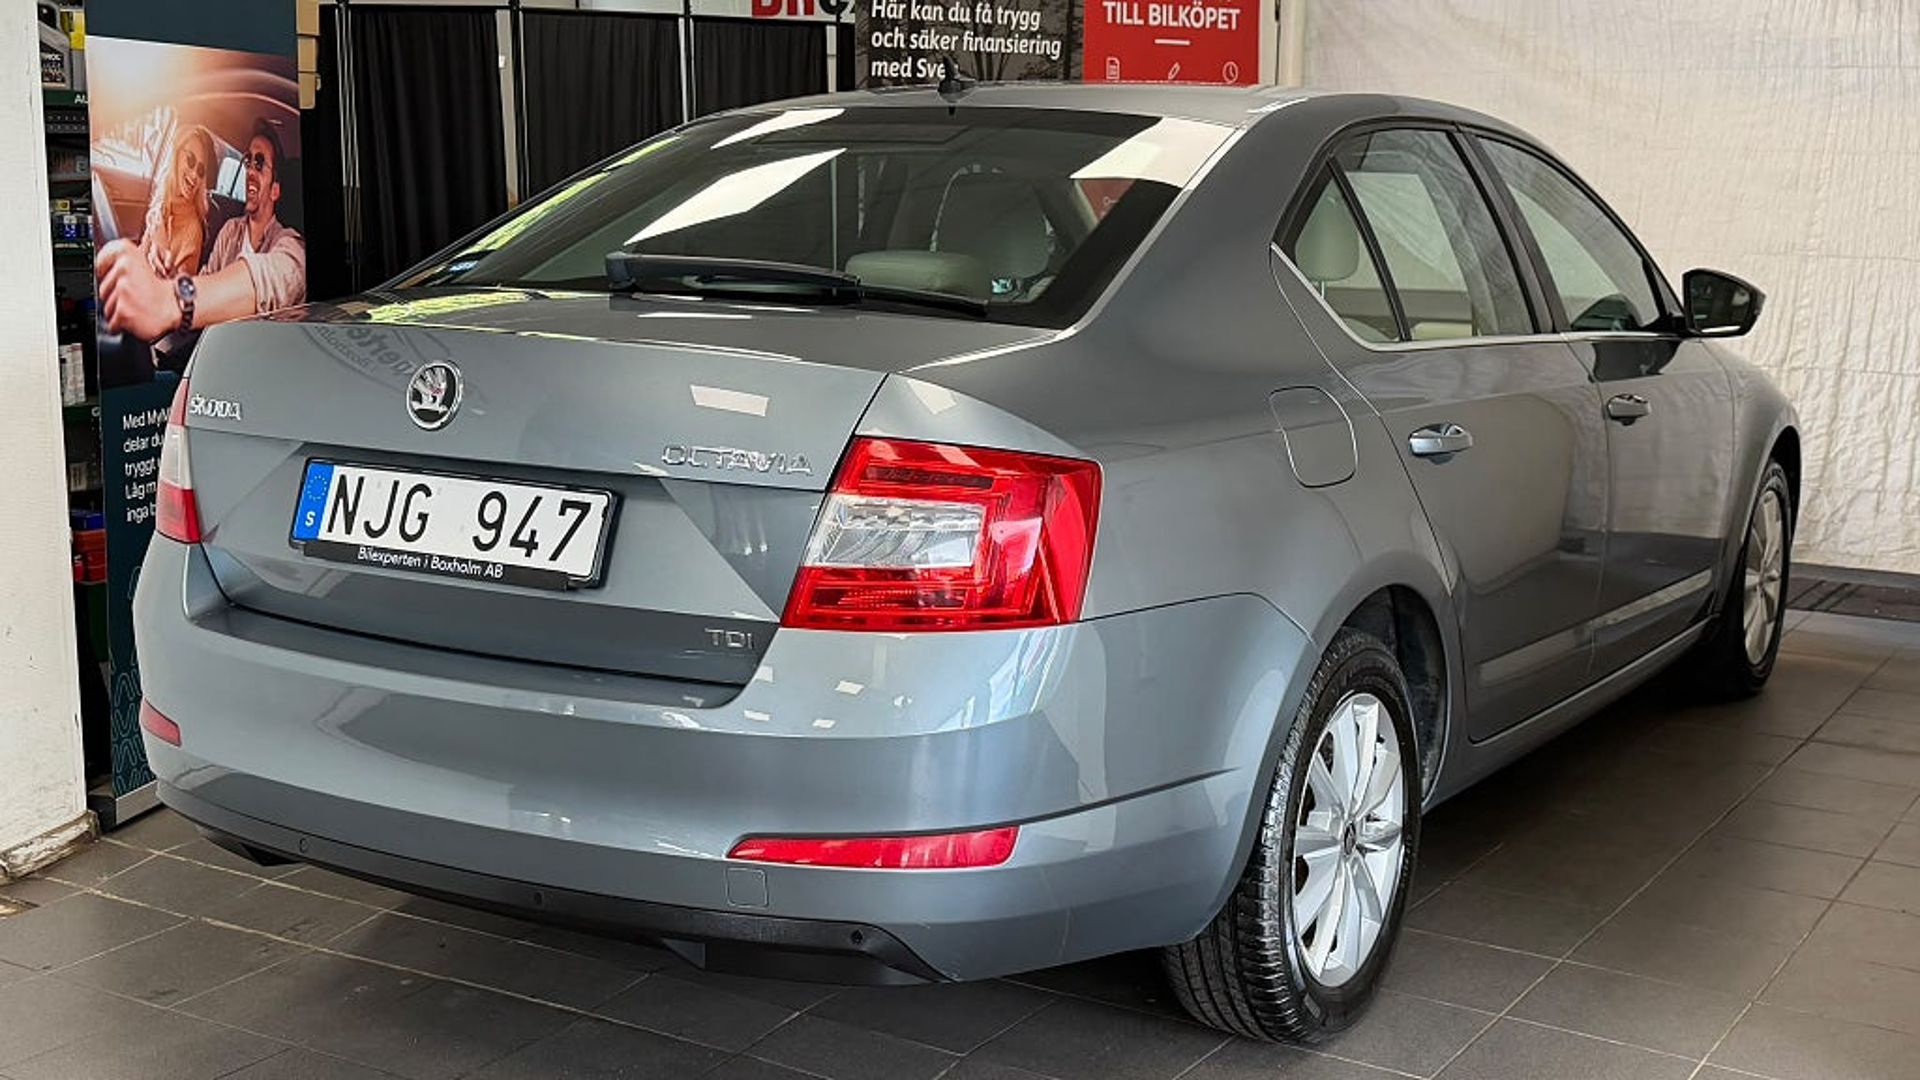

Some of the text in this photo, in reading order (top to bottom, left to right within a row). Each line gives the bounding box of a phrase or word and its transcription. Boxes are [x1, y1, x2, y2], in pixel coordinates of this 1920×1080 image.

[871, 0, 906, 19] Här
[910, 0, 943, 22] kan
[948, 1, 970, 23] du
[974, 2, 993, 24] få
[997, 6, 1042, 31] trygg
[1102, 0, 1241, 30] TILL BILKÖPET
[871, 27, 1062, 60] och säker finansiering
[871, 56, 912, 78] med
[123, 411, 146, 430] Med
[123, 436, 149, 453] delar
[124, 457, 156, 478] tryggt
[661, 445, 814, 476] OCTAVIA
[125, 482, 145, 499] Låg
[126, 506, 149, 523] inga
[304, 511, 317, 527] S
[326, 474, 592, 562] NJG 947
[357, 546, 503, 578] Bilexperten i Boxholm AB
[704, 628, 754, 650] TDI
